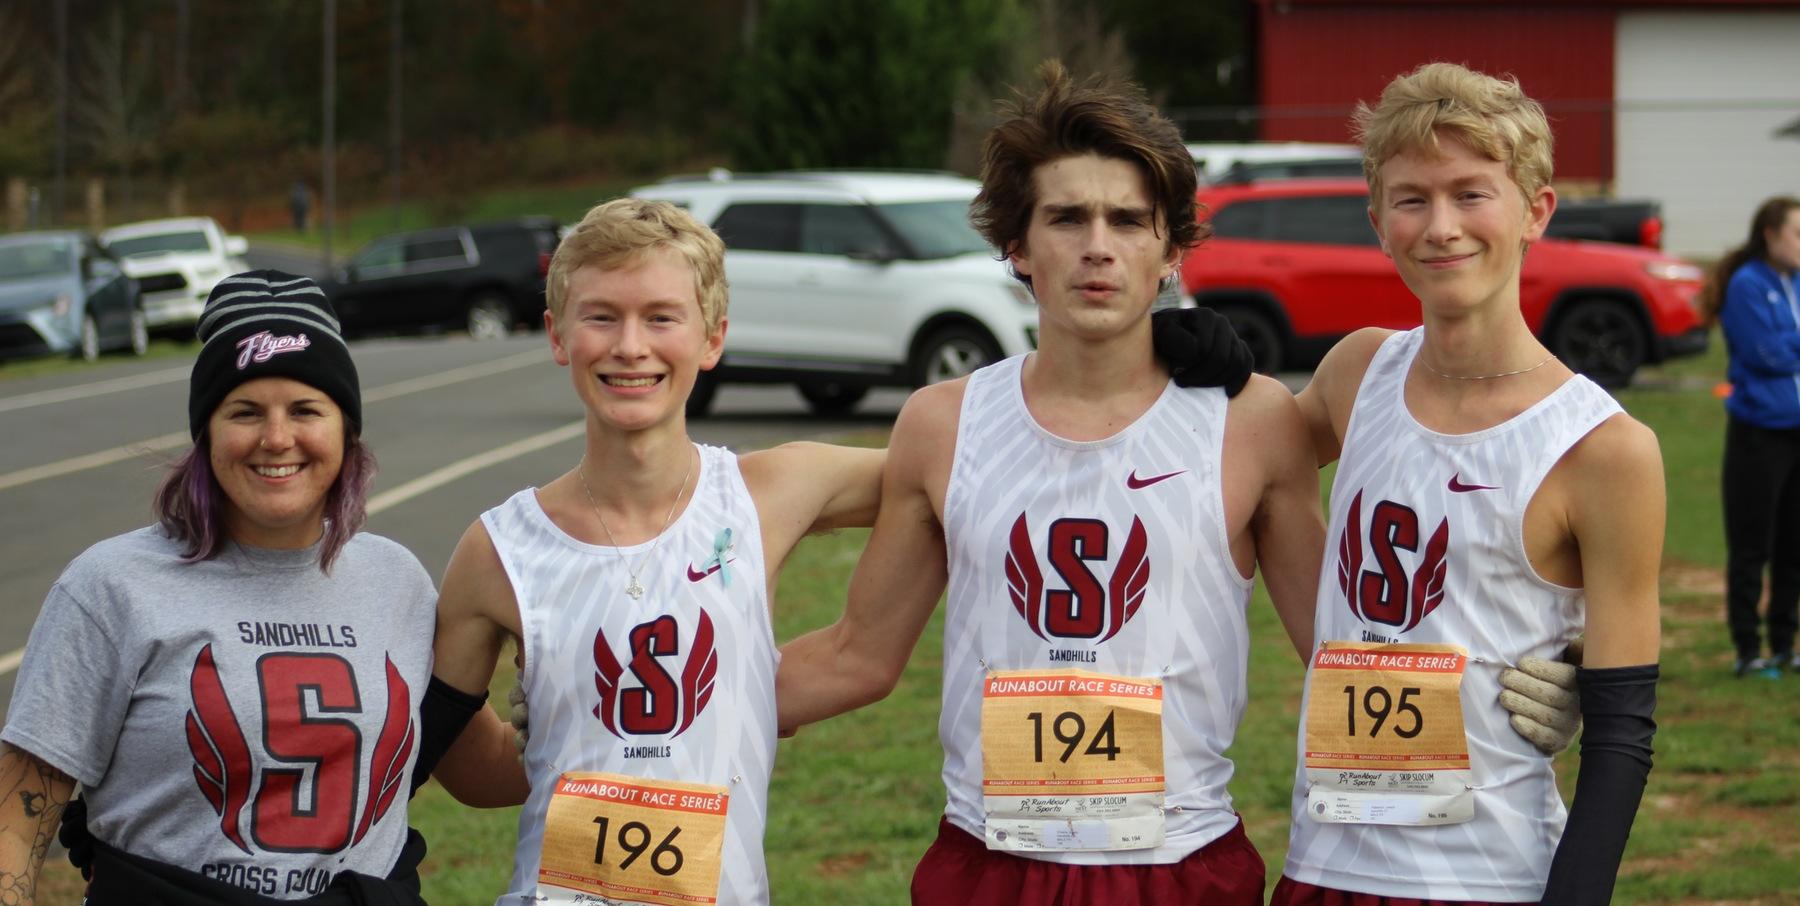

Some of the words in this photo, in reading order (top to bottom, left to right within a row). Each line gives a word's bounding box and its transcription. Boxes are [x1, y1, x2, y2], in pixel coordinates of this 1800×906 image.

[236, 330, 311, 370] Flyers
[1360, 500, 1418, 626] S
[1045, 518, 1108, 638] S
[237, 621, 357, 648] SANDHILLS
[1049, 649, 1097, 663] SANDHILLS
[1318, 653, 1377, 666] RUNABOUT
[1379, 656, 1413, 668] RACE
[1416, 657, 1458, 669] SERIES
[620, 615, 678, 735] S
[990, 680, 1065, 694] RUNABOUT
[1068, 680, 1105, 692] RACE
[1108, 683, 1154, 696] SERIES
[1343, 685, 1423, 739] 195
[1026, 709, 1121, 764] 194
[250, 651, 363, 855] S
[623, 745, 671, 759] SANDHILLS
[562, 782, 638, 801] RUNABOUT
[641, 792, 676, 806] RACE
[679, 797, 722, 811] SERIES
[1353, 779, 1376, 787] Sports
[1035, 805, 1062, 813] Sports
[1089, 797, 1103, 806] SKIP
[1104, 796, 1127, 805] SLOCUM
[592, 815, 684, 876] 196
